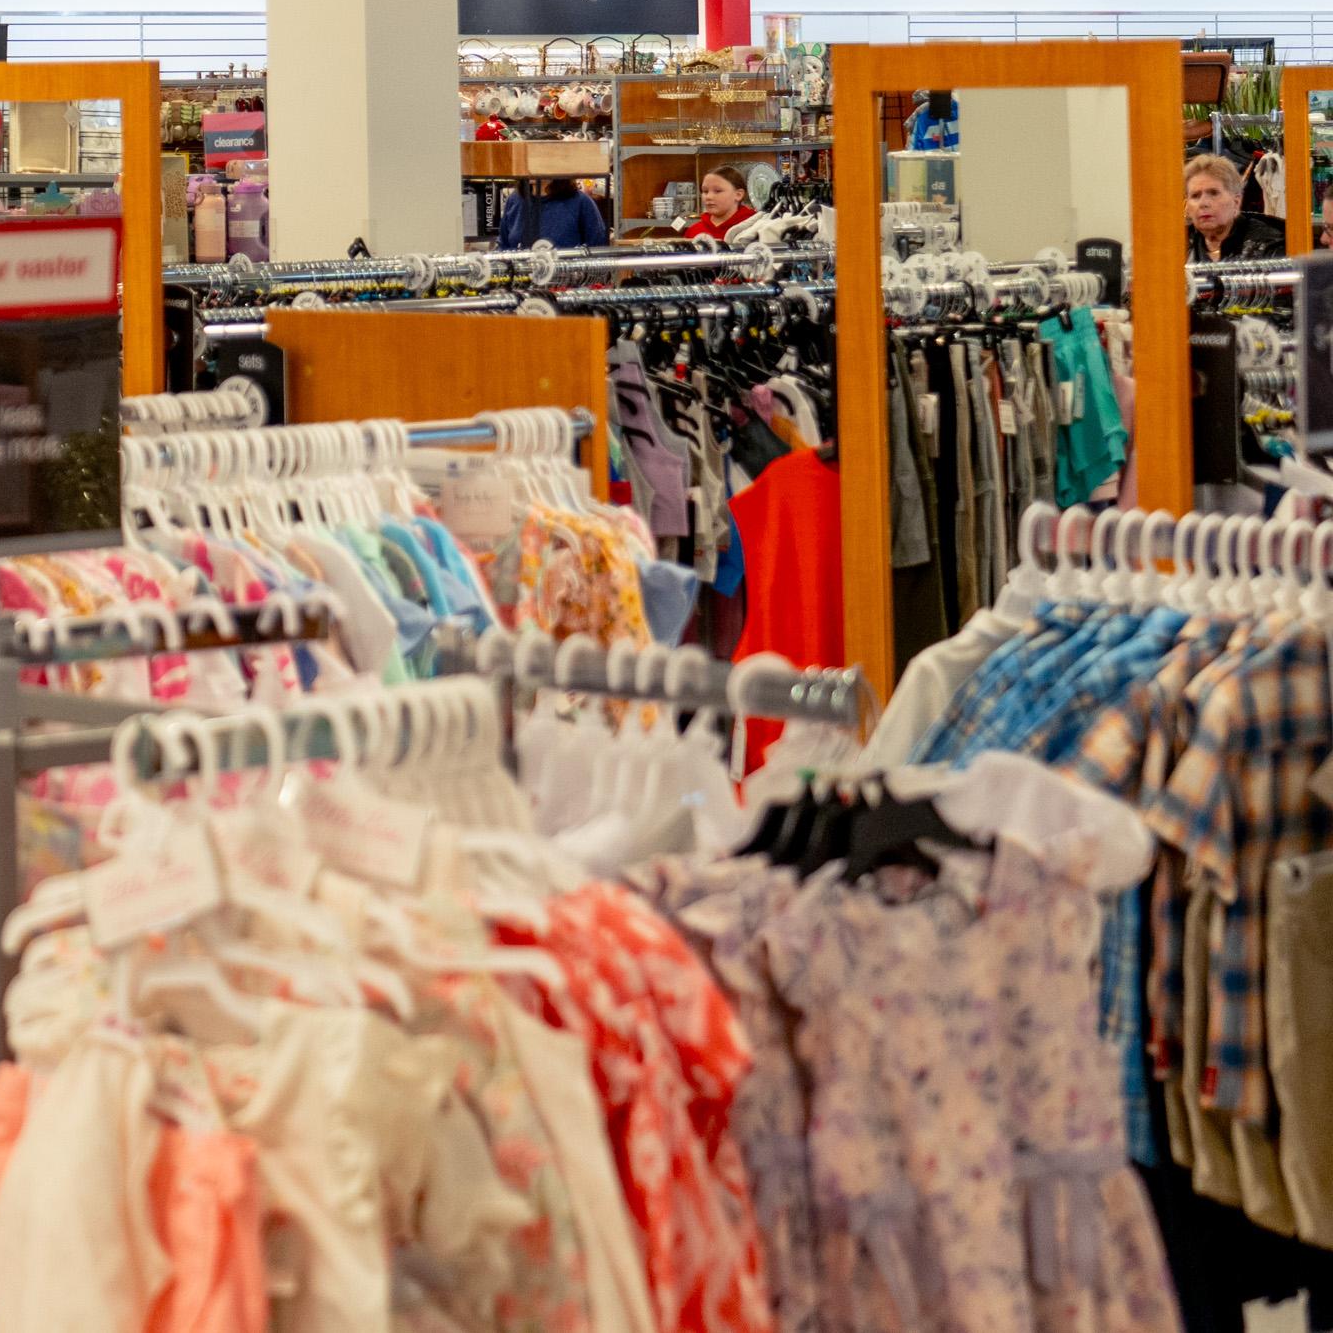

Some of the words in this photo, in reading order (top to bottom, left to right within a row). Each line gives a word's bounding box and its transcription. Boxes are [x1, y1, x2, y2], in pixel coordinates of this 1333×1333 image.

[213, 134, 255, 148] clearance
[16, 255, 88, 280] easter
[237, 353, 265, 369] sets
